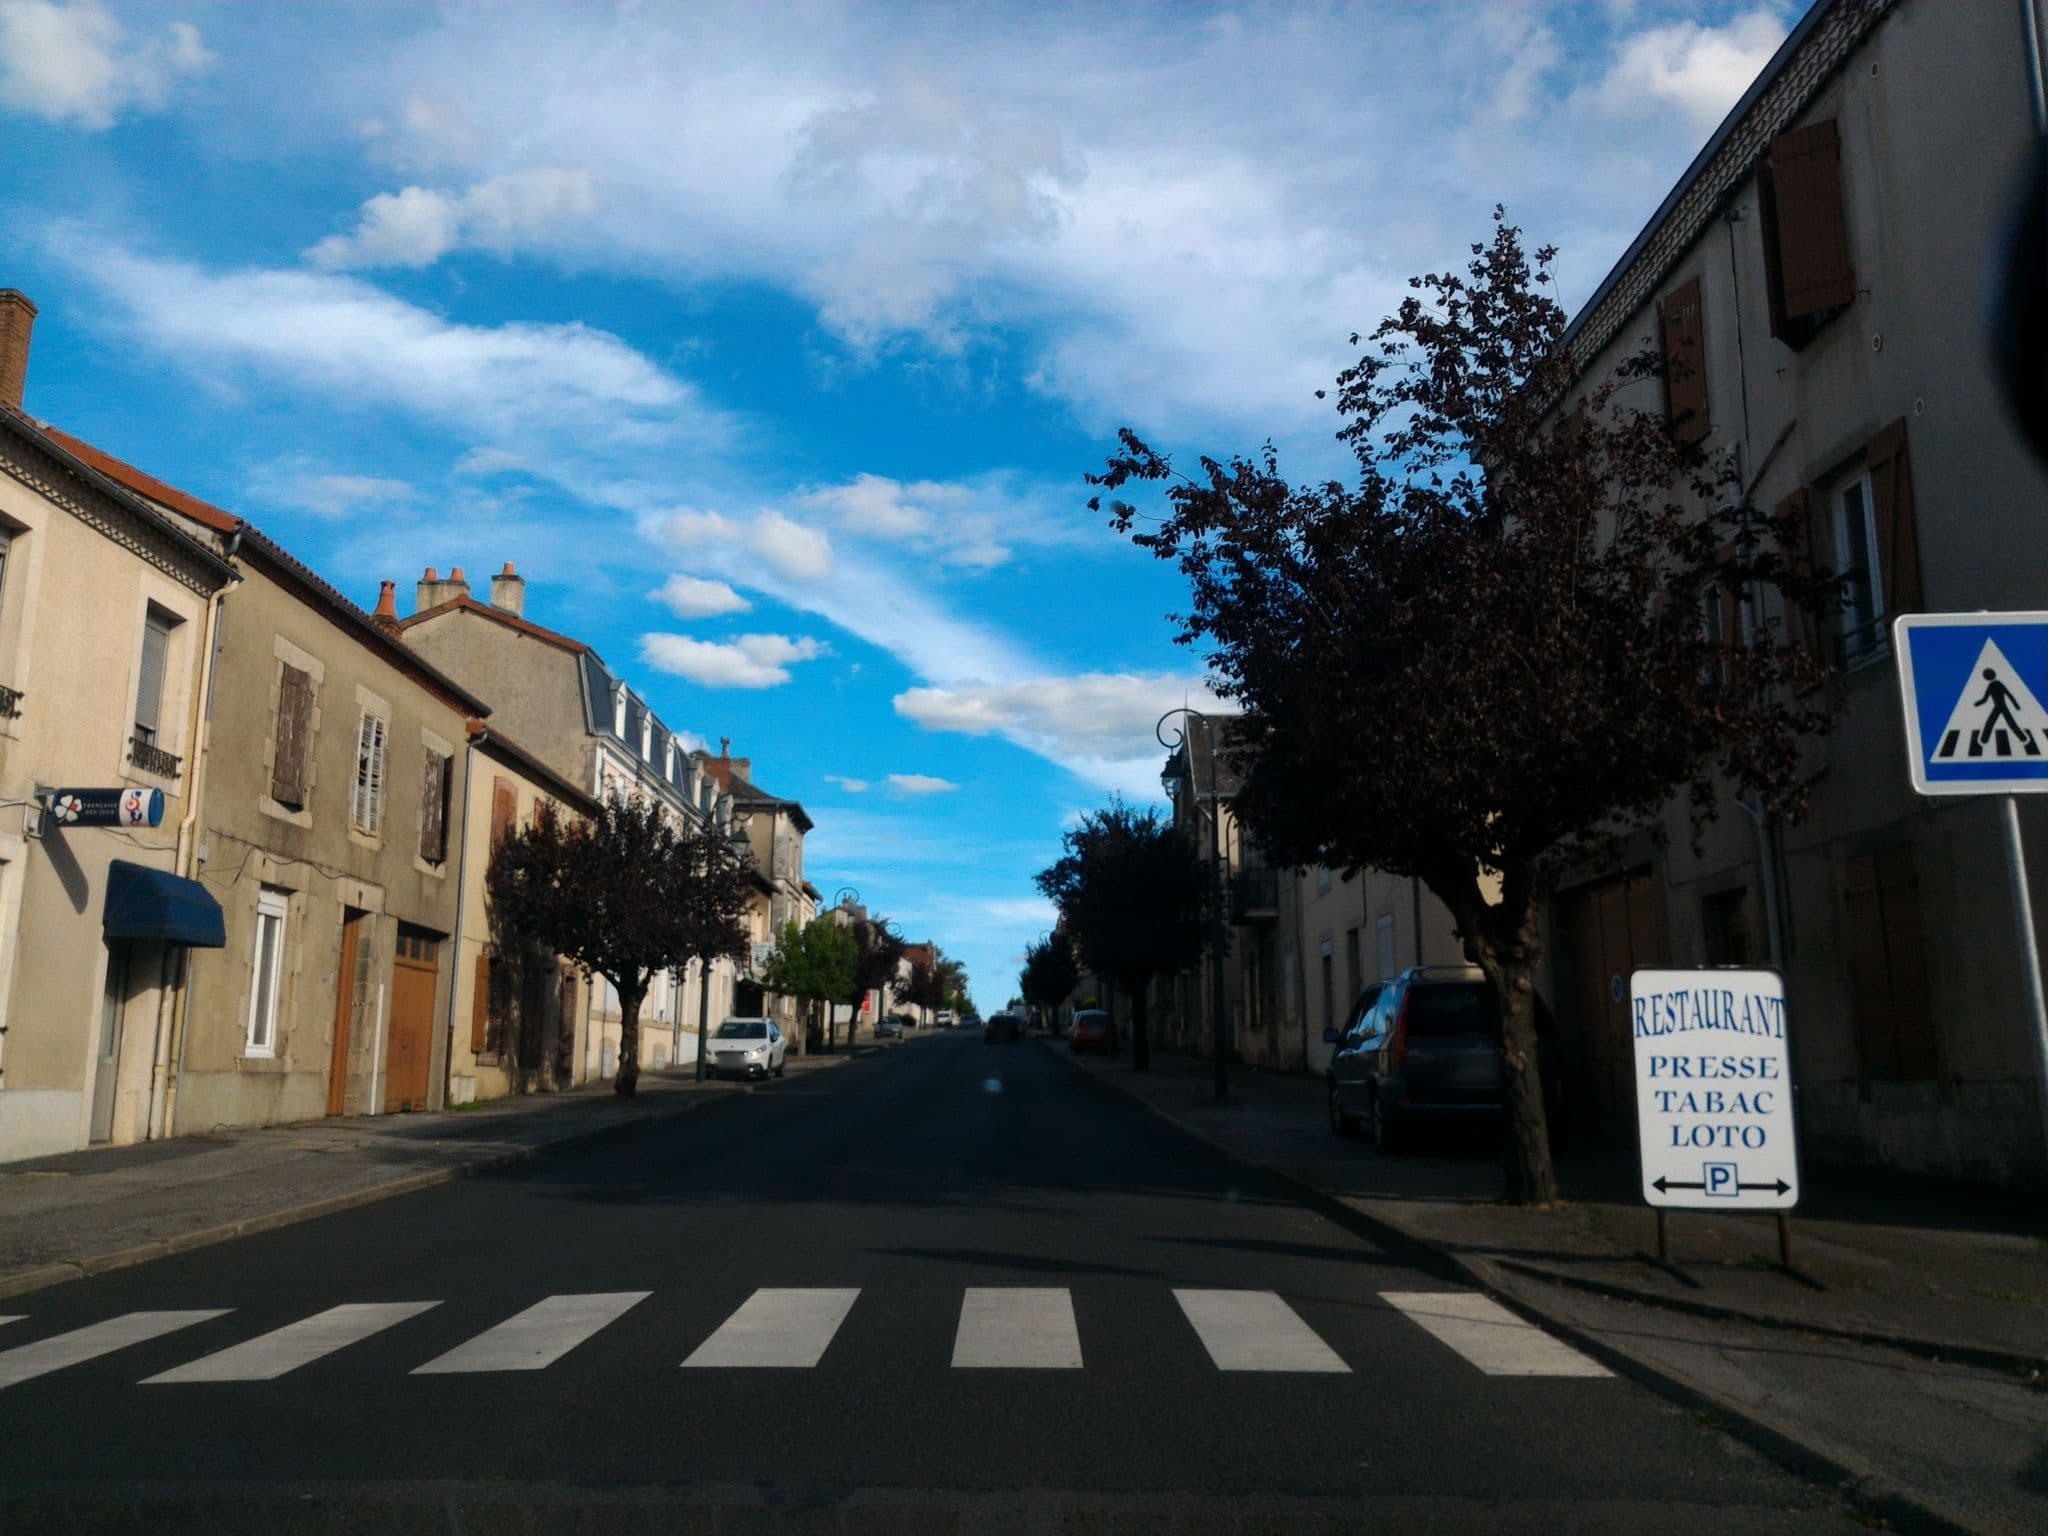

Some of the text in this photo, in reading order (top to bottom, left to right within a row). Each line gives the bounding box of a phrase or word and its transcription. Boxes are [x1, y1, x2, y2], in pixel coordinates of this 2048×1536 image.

[1634, 989, 1785, 1039] RESTAURANT
[1648, 1056, 1779, 1079] PRESSE
[1654, 1090, 1774, 1114] TABAC
[1670, 1125, 1766, 1149] LOTO
[1710, 1167, 1730, 1192] P
